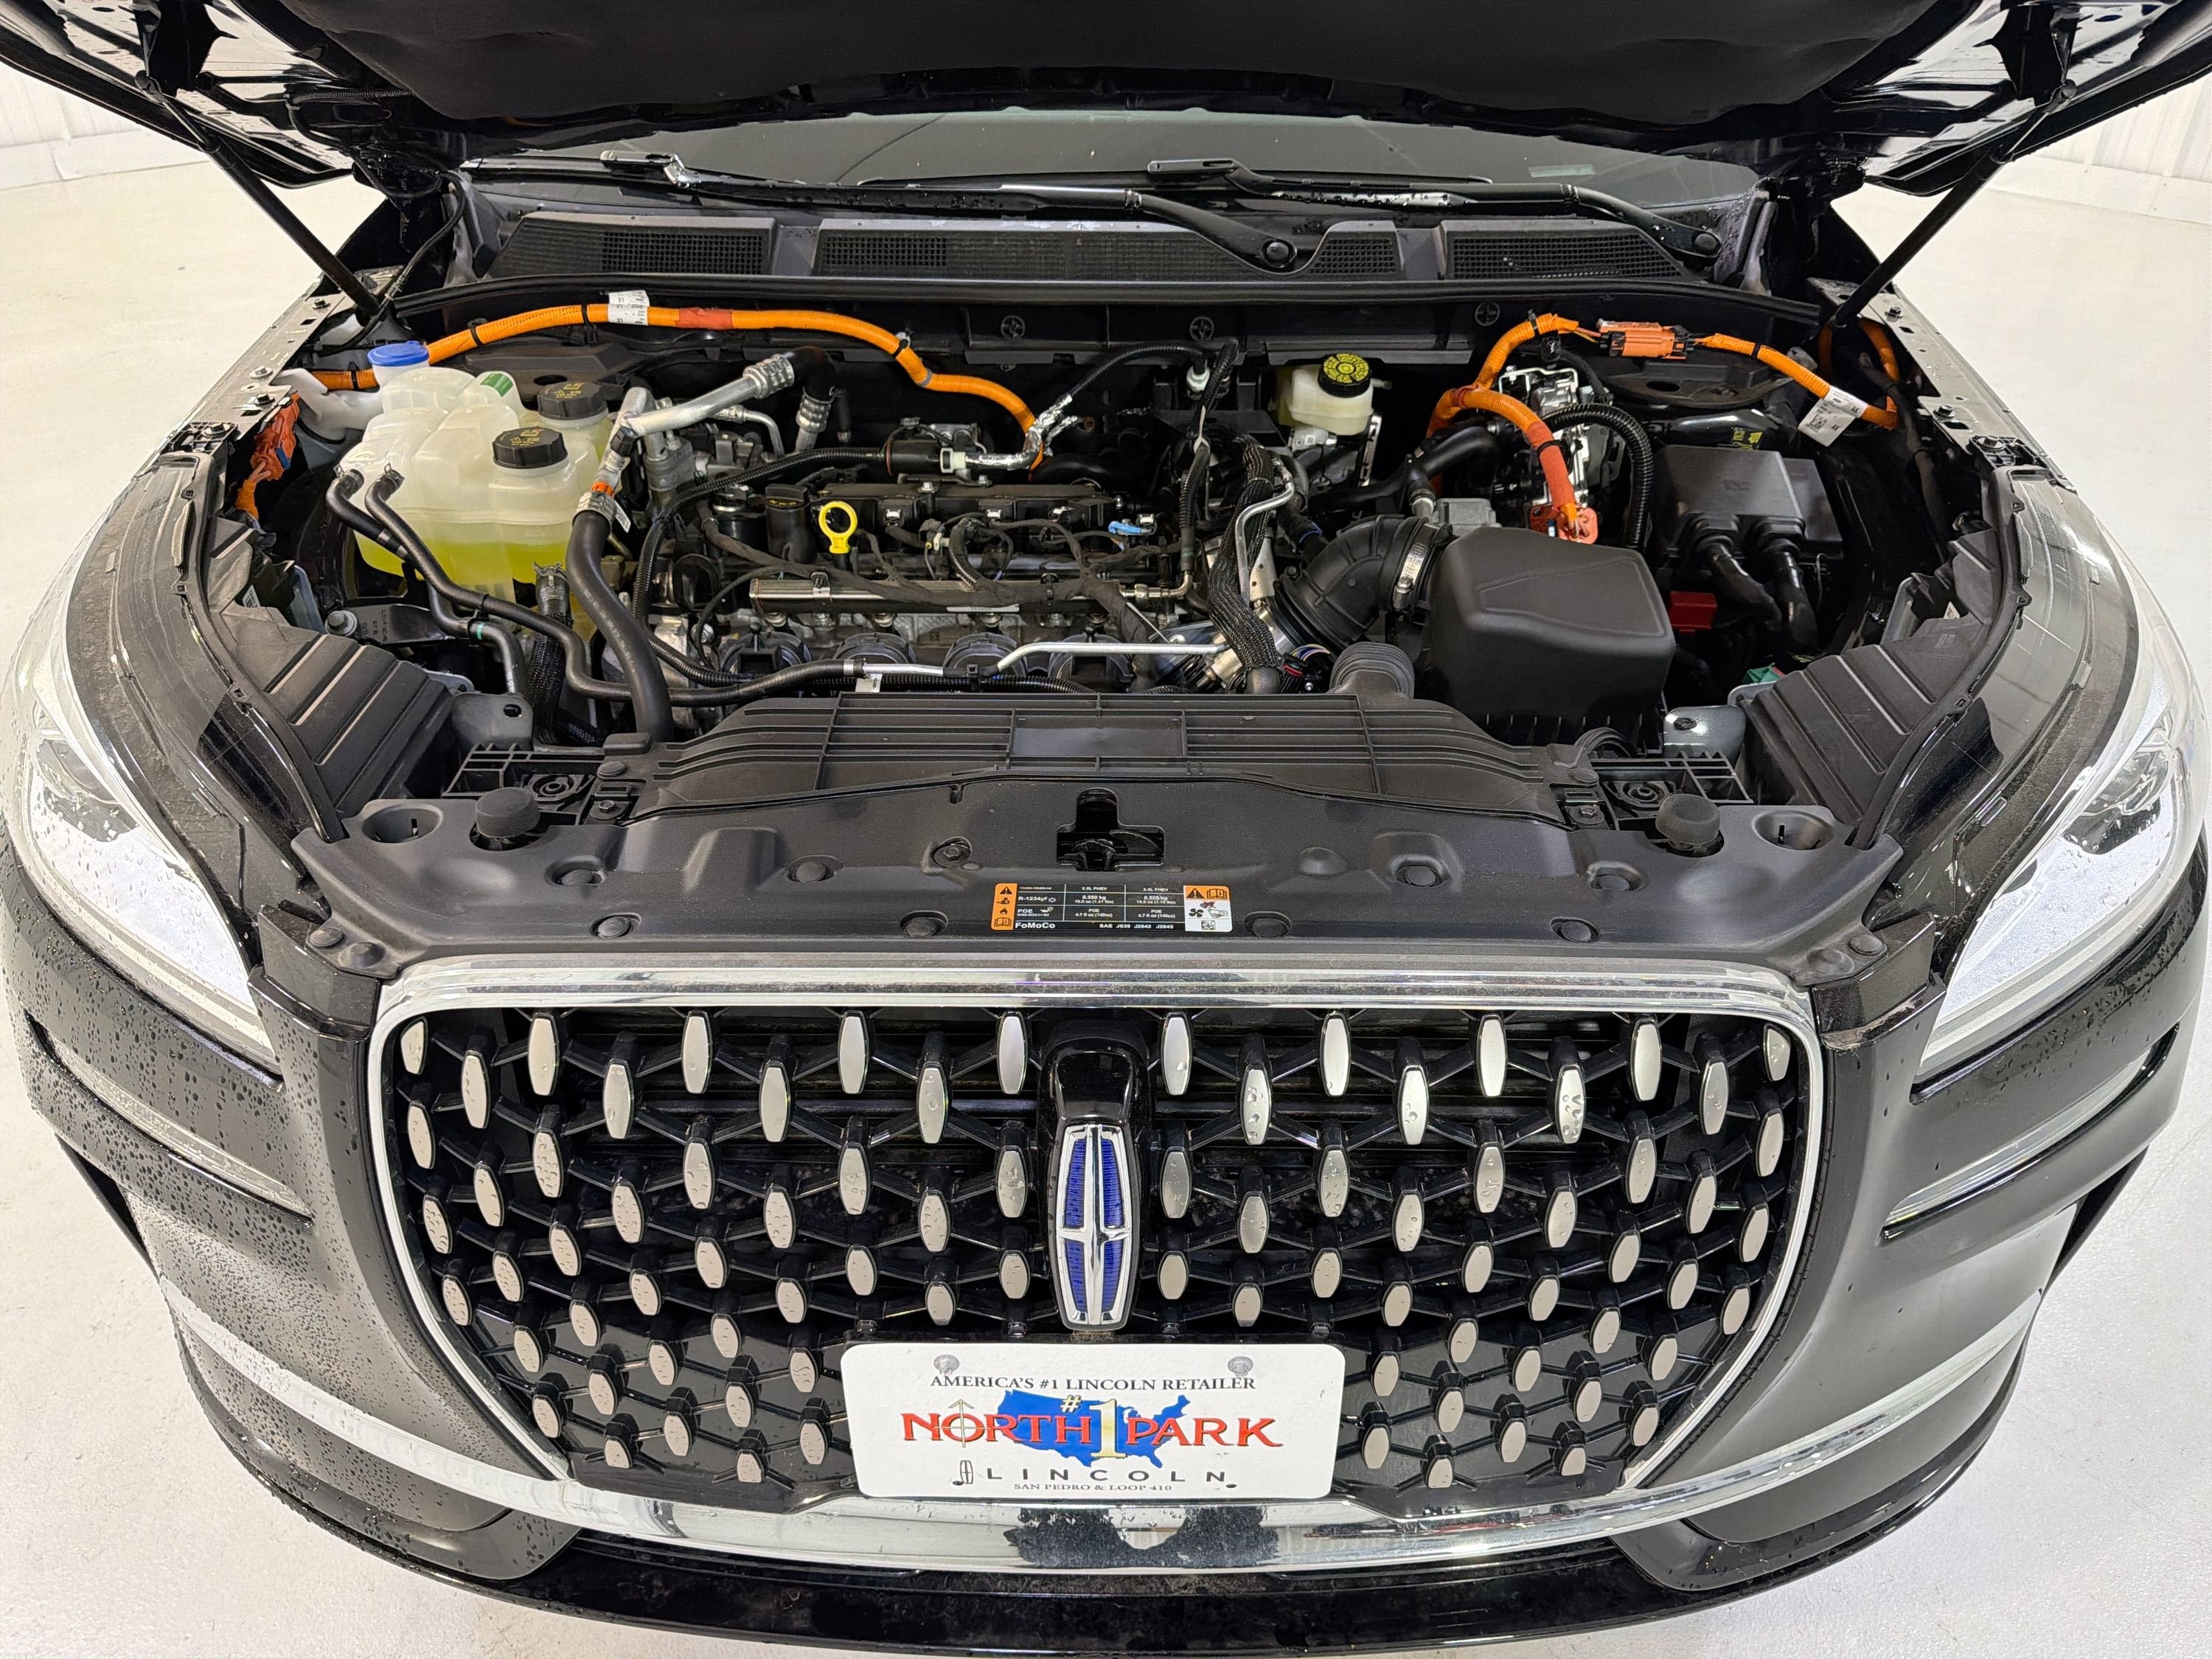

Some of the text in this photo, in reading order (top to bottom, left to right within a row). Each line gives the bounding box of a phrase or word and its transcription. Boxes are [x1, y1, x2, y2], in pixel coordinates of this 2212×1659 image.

[930, 1376, 1256, 1391] AMERICA'S #1 LINCOLN RETAILER
[900, 1412, 1284, 1447] NORTH PARK
[987, 1467, 1225, 1483] LINCOLN
